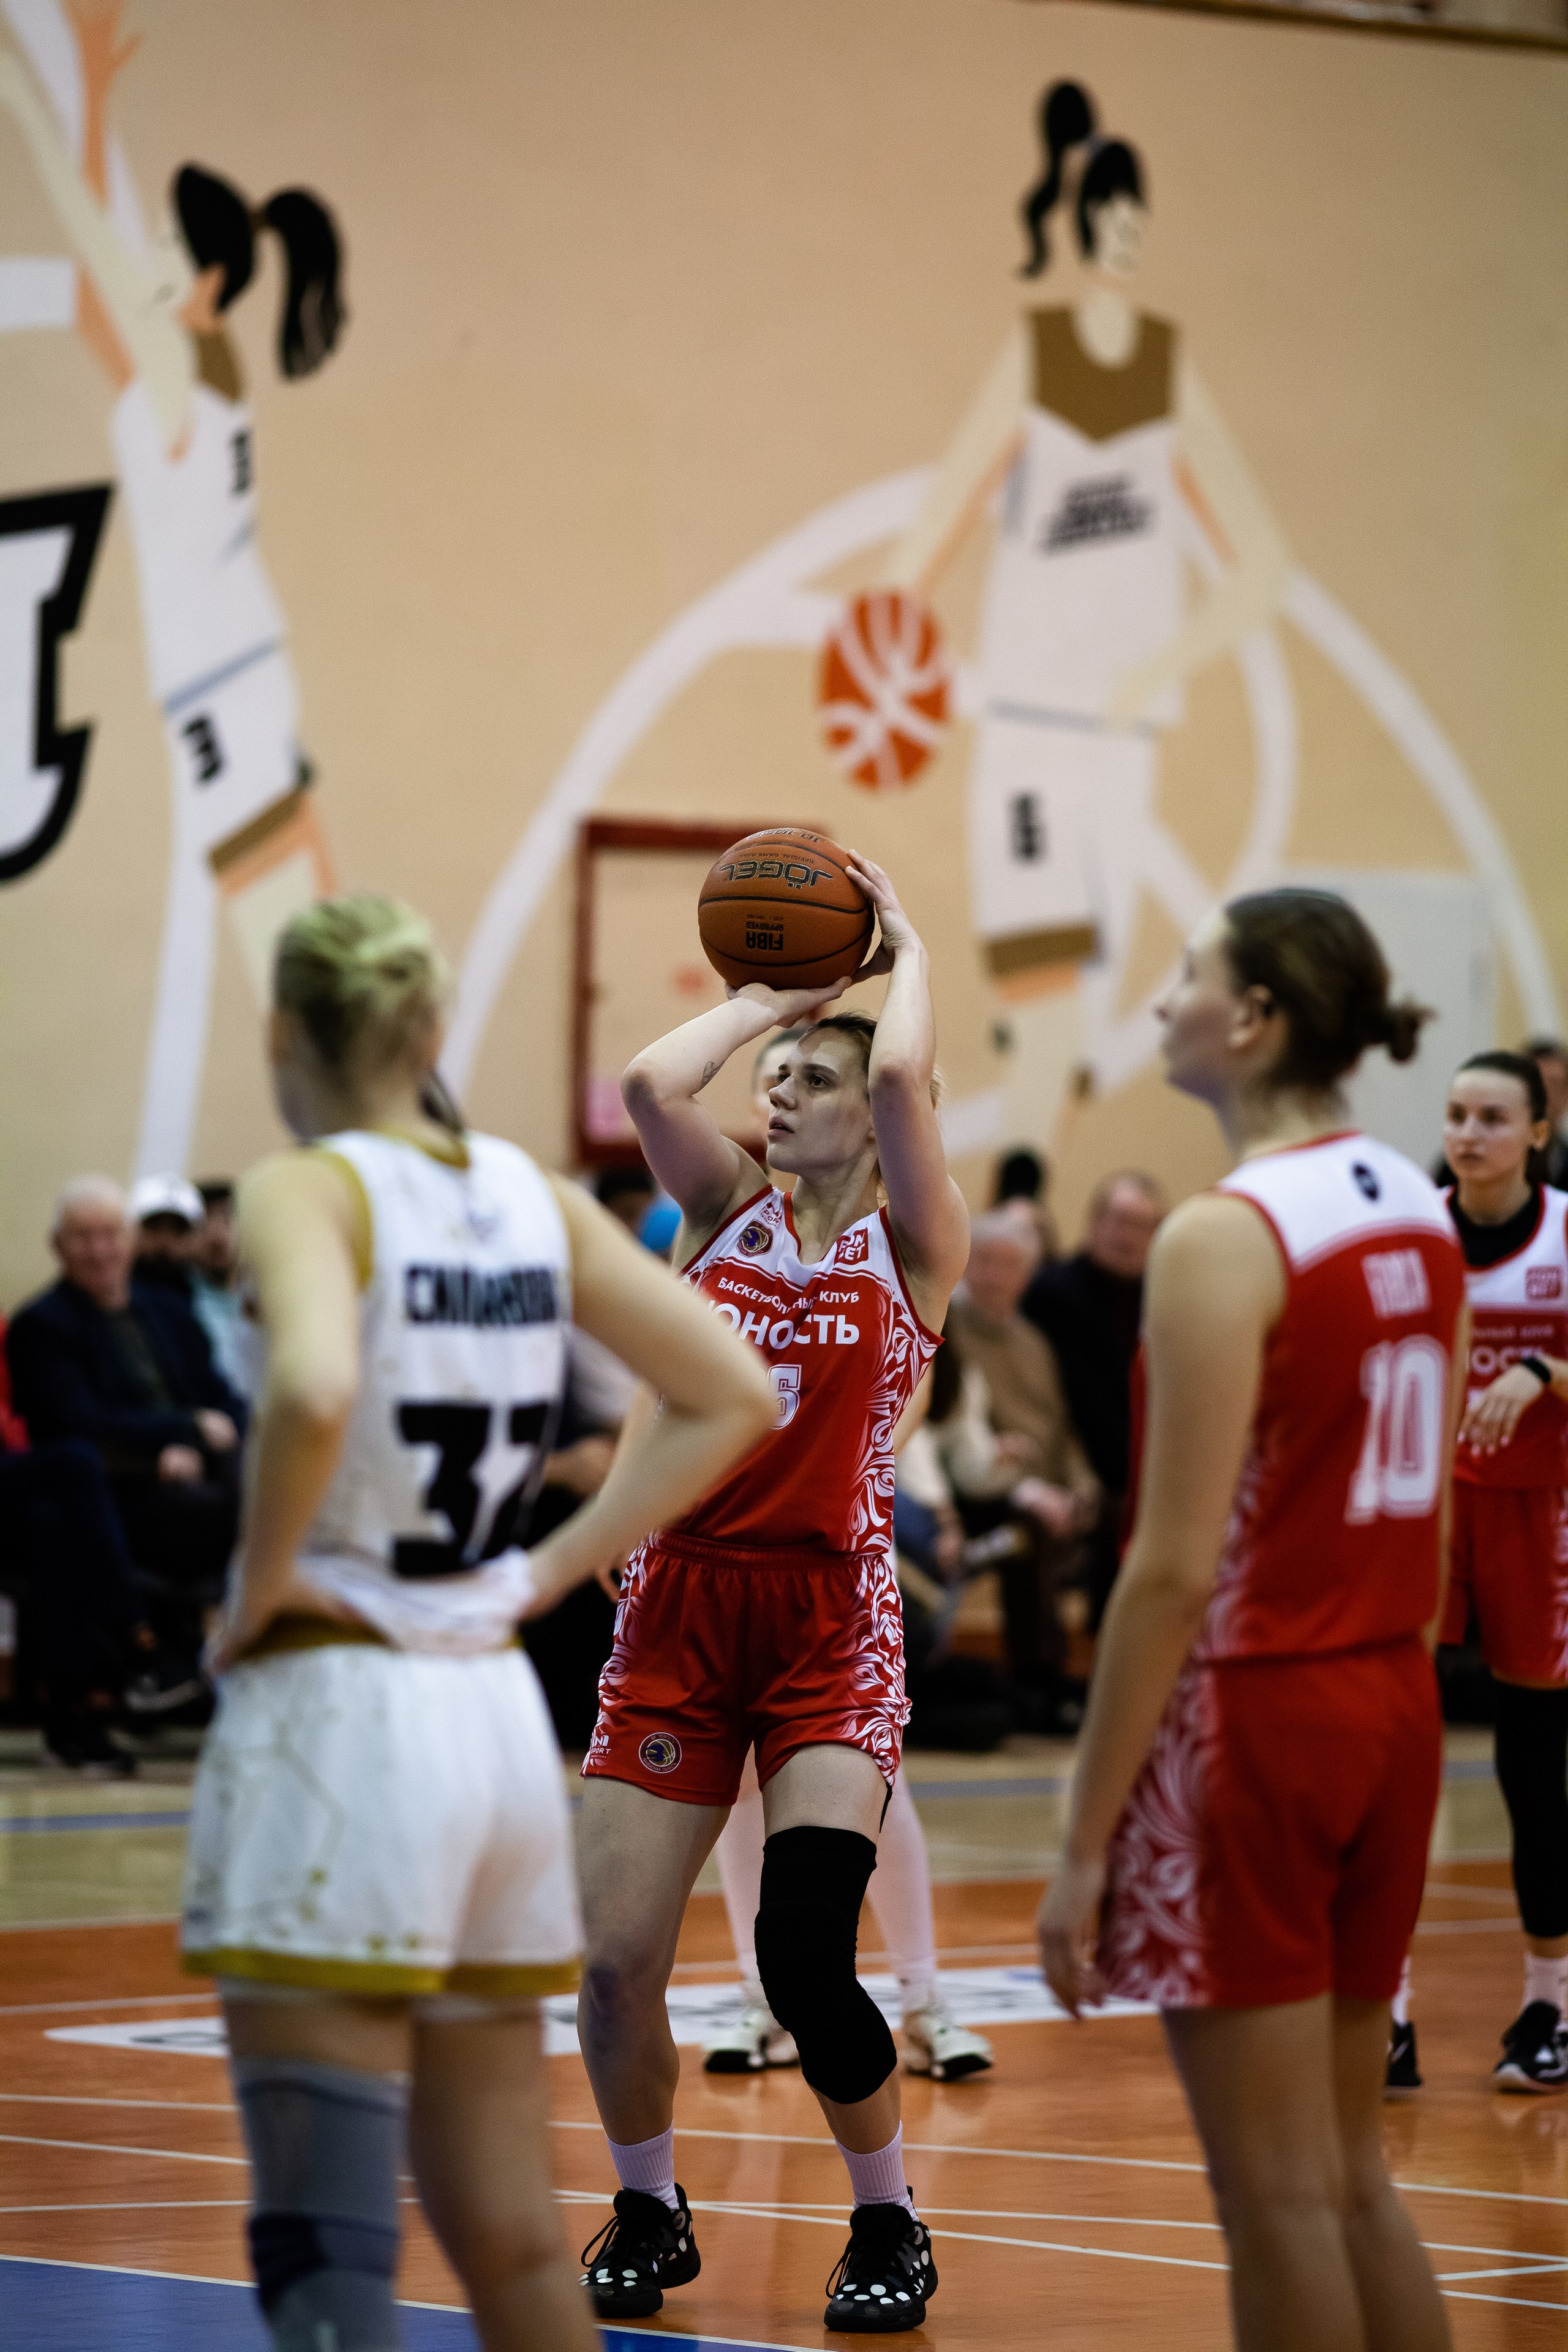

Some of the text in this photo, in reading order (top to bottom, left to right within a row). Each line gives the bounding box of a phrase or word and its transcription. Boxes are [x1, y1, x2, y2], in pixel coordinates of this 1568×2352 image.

[720, 860, 834, 889] JÖGEL
[746, 921, 784, 931] APPROVED
[746, 931, 783, 951] FIBA
[820, 1290, 860, 1303] КЛУБ
[1344, 1333, 1447, 1525] 10
